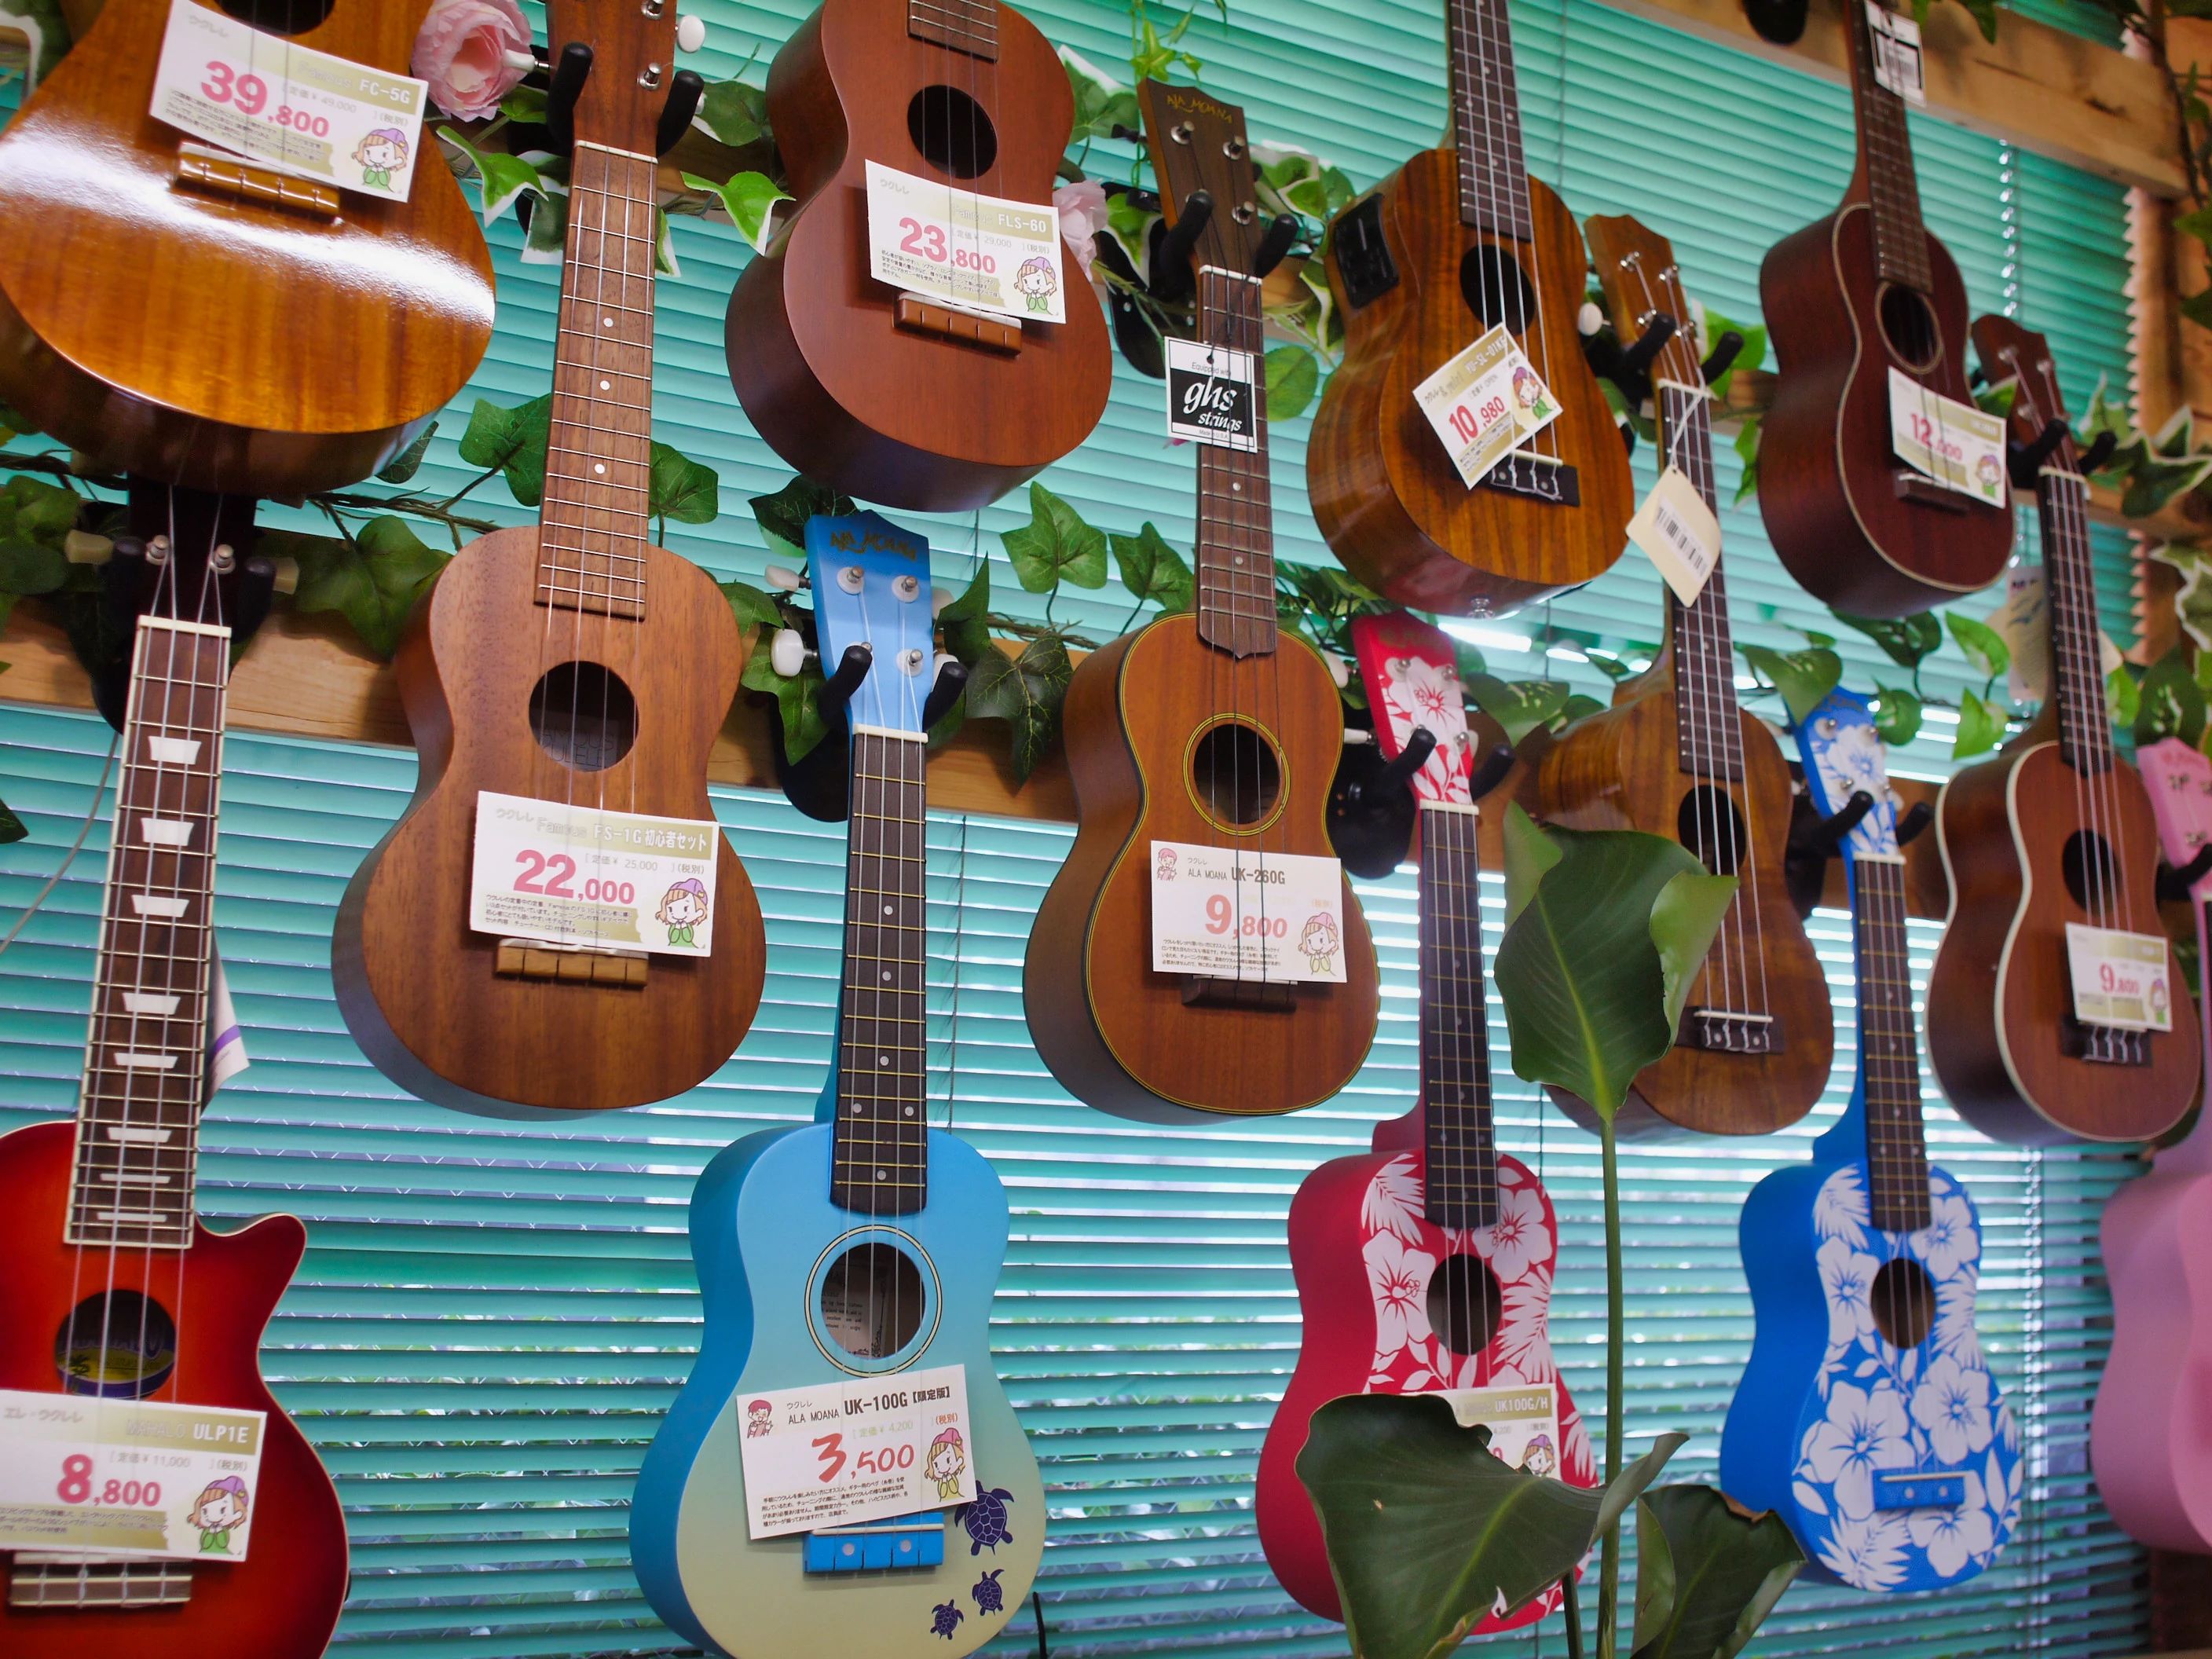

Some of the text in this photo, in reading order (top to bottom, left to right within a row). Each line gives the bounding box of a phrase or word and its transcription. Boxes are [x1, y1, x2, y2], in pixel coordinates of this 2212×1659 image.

[201, 60, 330, 138] 39,800
[358, 79, 411, 104] FC-5G
[998, 213, 1046, 233] FLS-60
[899, 217, 996, 274] 23,800
[1183, 376, 1237, 414] ghs
[1198, 412, 1242, 432] strings
[1449, 396, 1505, 445] 10,980
[593, 826, 641, 845] FS-1G
[645, 830, 707, 852] 初心者セット
[513, 848, 635, 905] 22,000
[624, 859, 658, 871] 25,000
[1188, 866, 1285, 884] ALA MOANA UK-260G
[1205, 894, 1287, 939] 9,800
[786, 1400, 812, 1410] ウクレレ
[789, 1413, 806, 1425] ALA
[811, 1408, 840, 1421] MOANA
[844, 1392, 907, 1415] UK-100G
[1495, 1397, 1548, 1412] UK100G/H
[193, 1423, 249, 1443] ULP1E
[888, 1420, 914, 1433] 4,200
[811, 1432, 914, 1483] 3,500
[57, 1453, 161, 1507] 8,800
